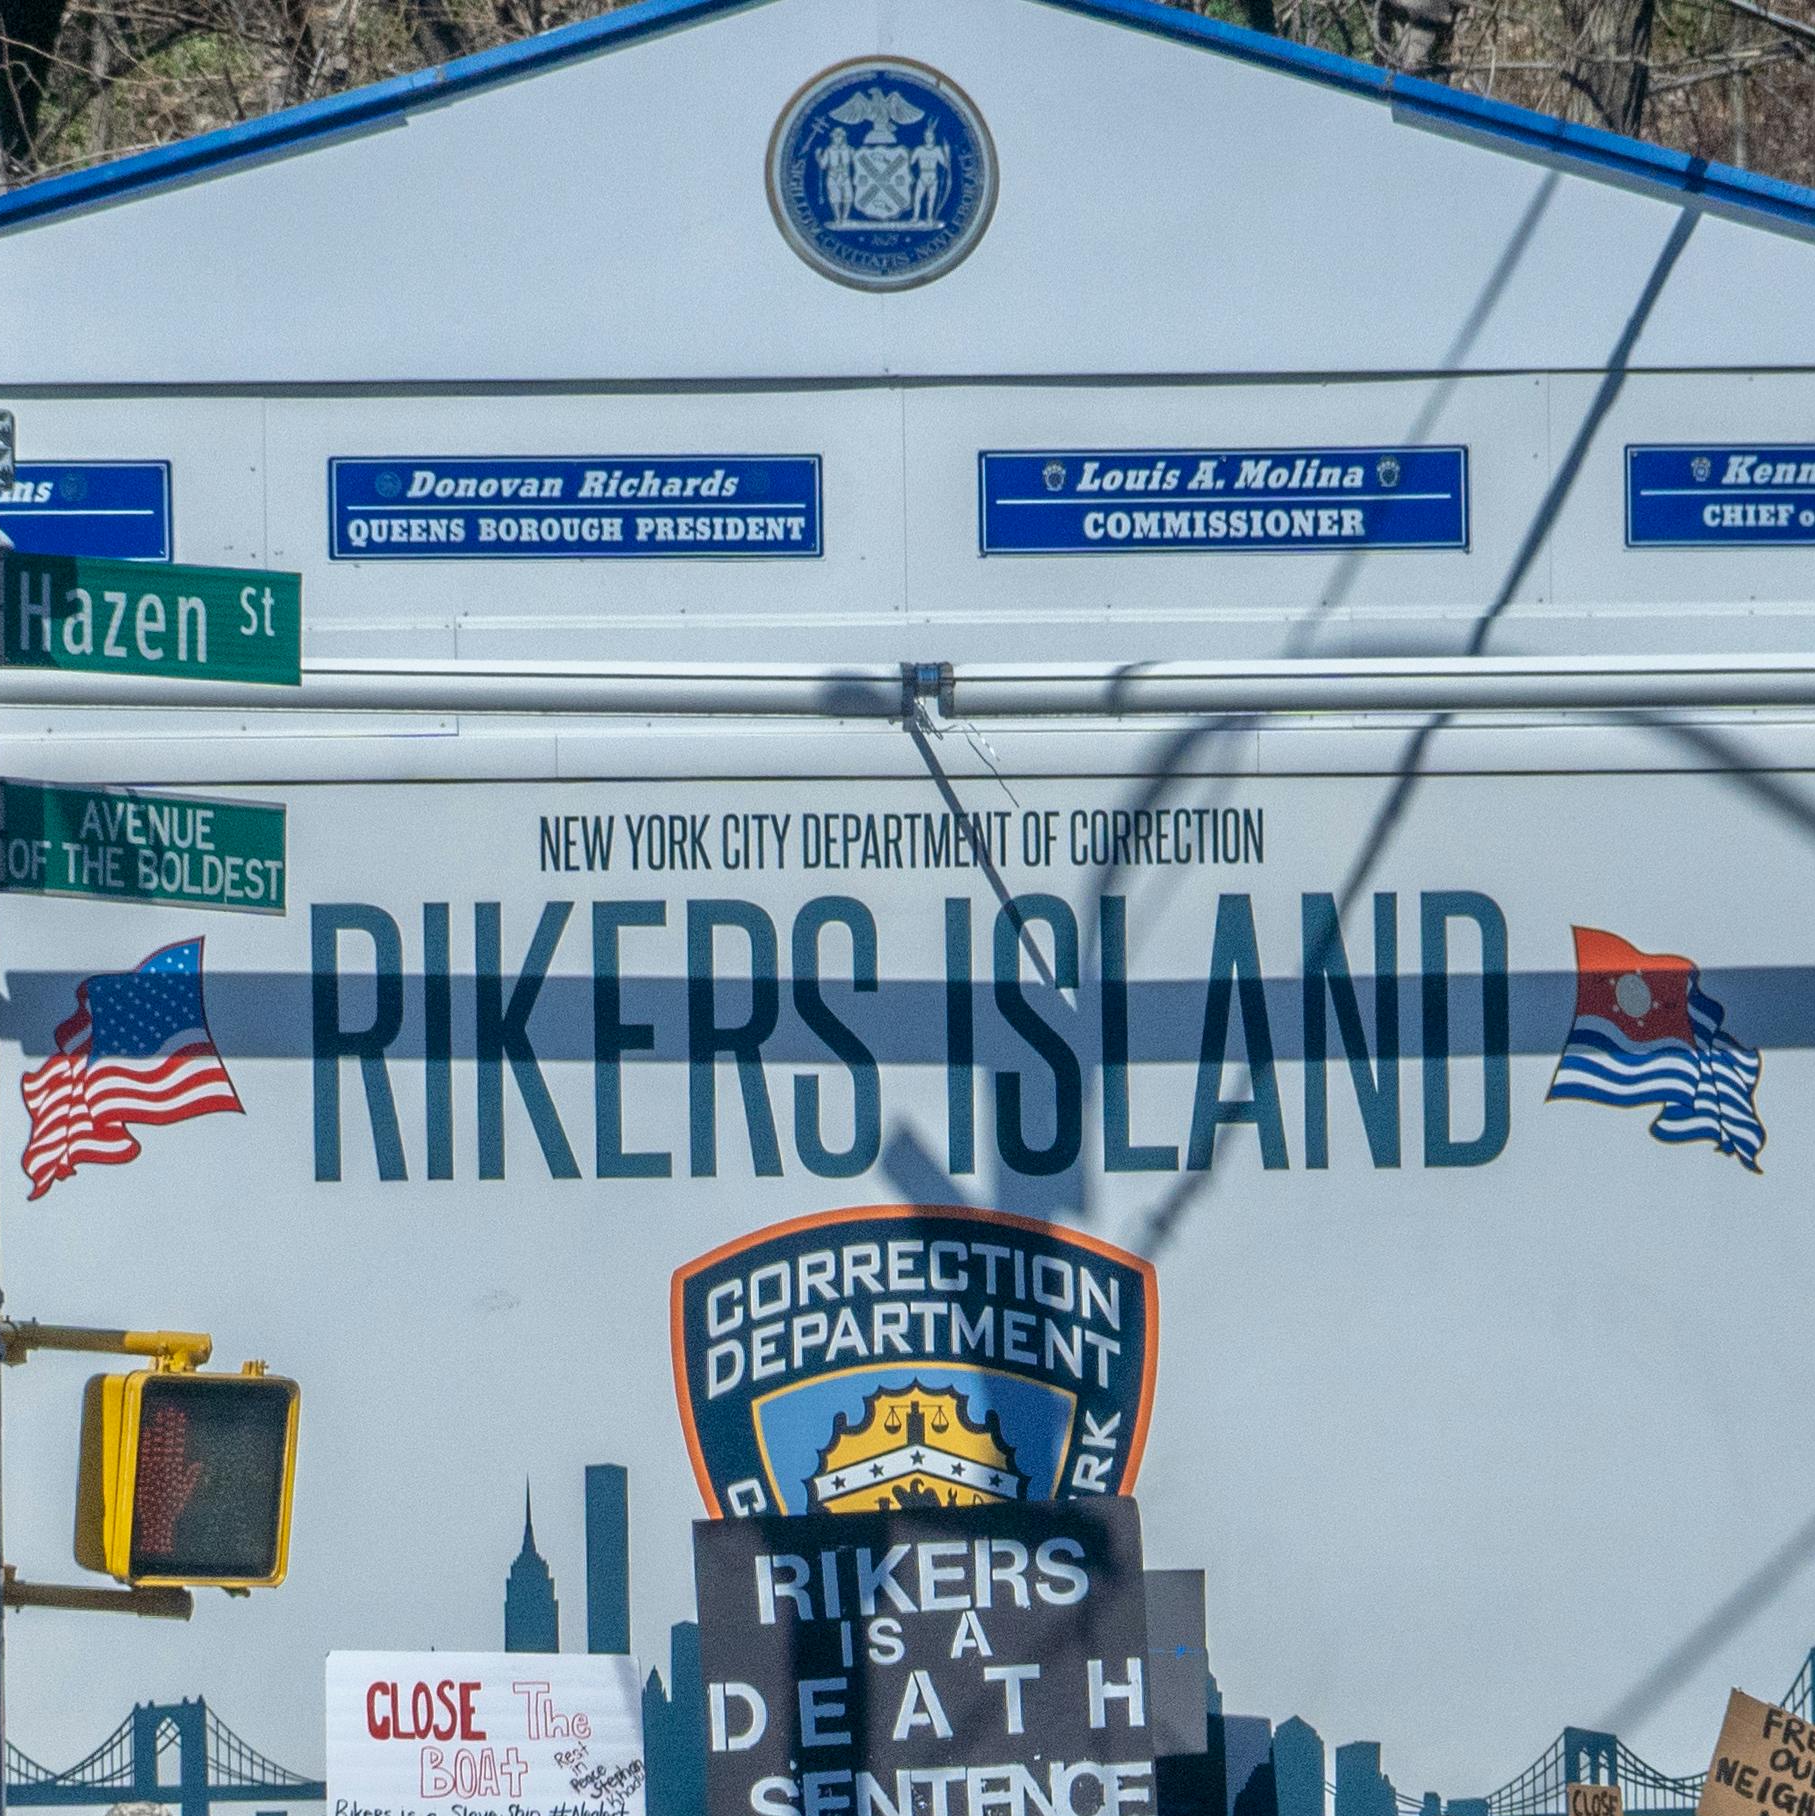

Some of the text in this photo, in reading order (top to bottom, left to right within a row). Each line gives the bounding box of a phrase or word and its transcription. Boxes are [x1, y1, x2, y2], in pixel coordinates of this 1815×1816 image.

[407, 470, 738, 498] Donovan Richards
[1076, 460, 1364, 491] Louis A. Molina
[347, 516, 805, 548] QUEENS BOROUGH PRESIDENT
[1084, 509, 1365, 540] COMMISSIONER
[1703, 505, 1793, 527] CHIEF
[20, 571, 275, 663] Hazen St
[80, 801, 215, 850] AVENUE
[538, 808, 1266, 873] NEW YORK CITY DEPARTMENT OF CORRECTION
[7, 838, 283, 901] OF THE BOLDEST
[310, 890, 1511, 1182] RIKERS ISLAND
[707, 1240, 1120, 1338] CORRECTION
[707, 1302, 1122, 1399] DEPARTMENT
[754, 1537, 1090, 1624] RIKERS
[841, 1610, 994, 1668] IS A
[366, 1680, 592, 1741] CLOSE The
[709, 1657, 1146, 1752] DEATH
[554, 1741, 589, 1768] Rest
